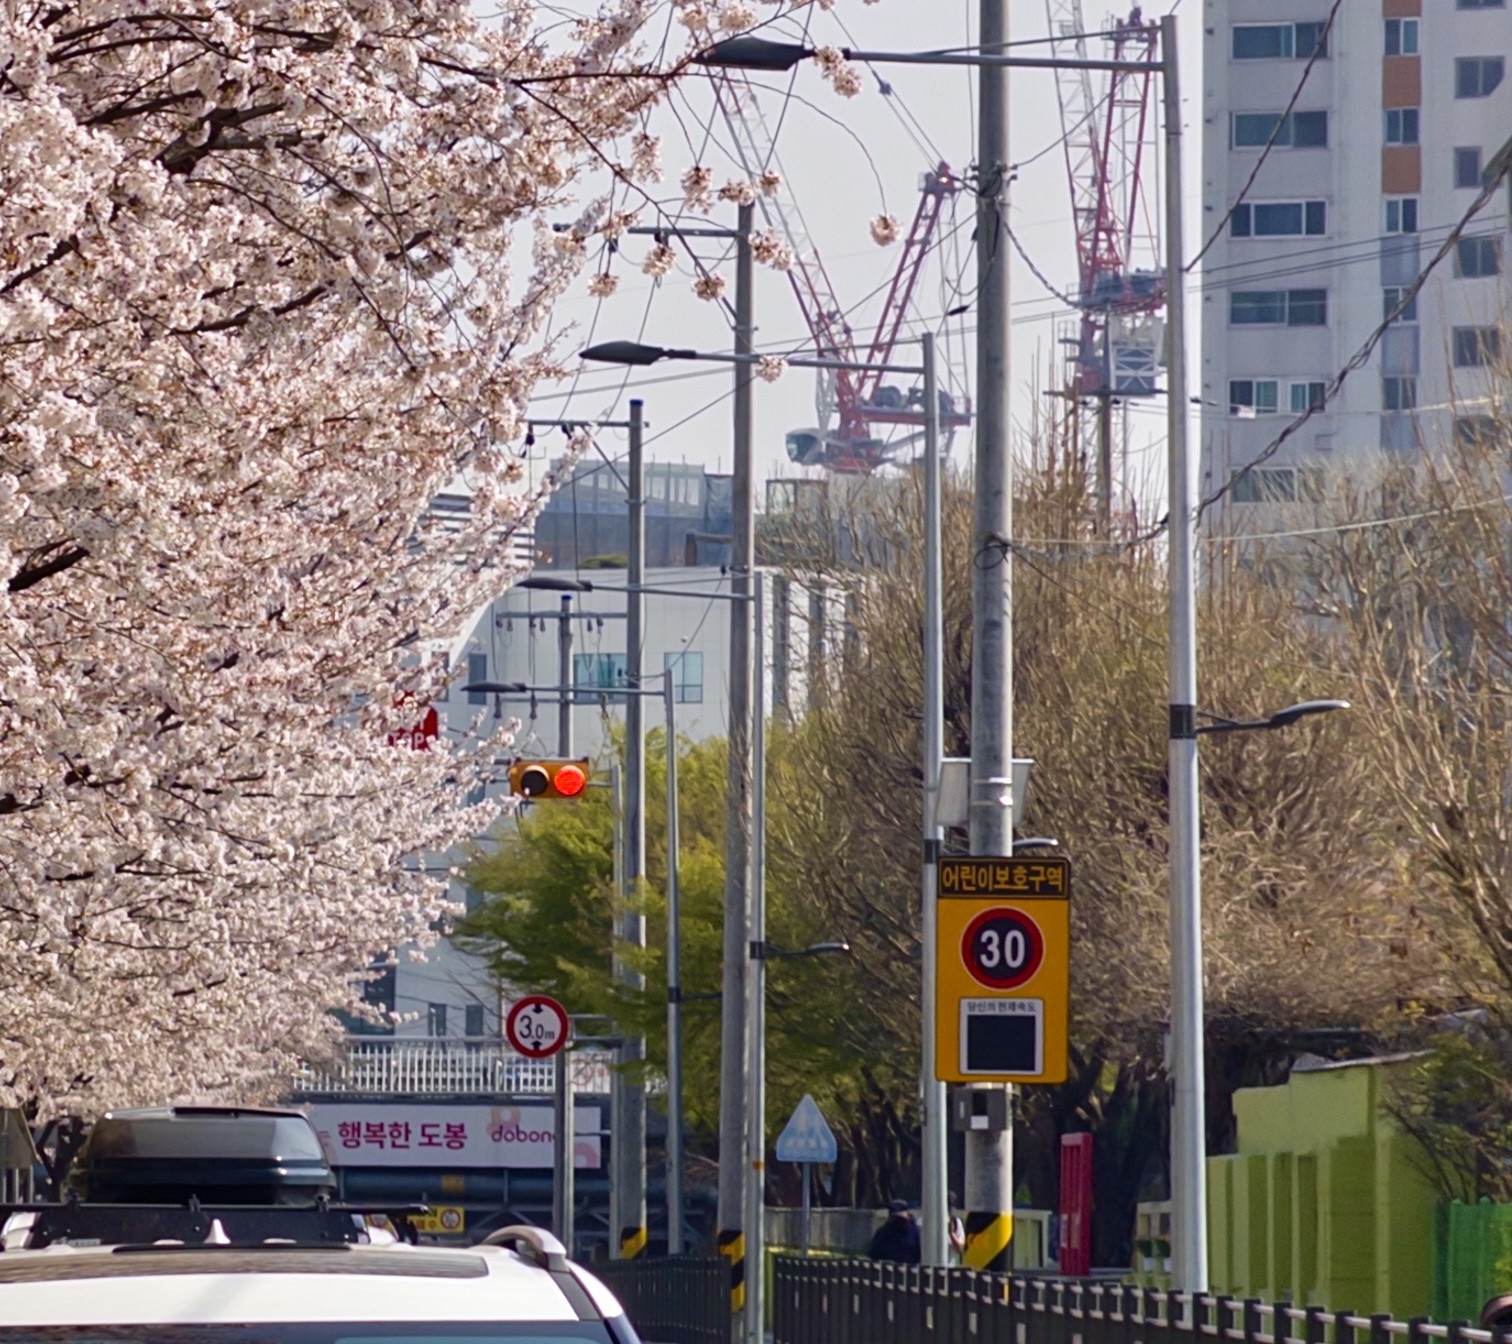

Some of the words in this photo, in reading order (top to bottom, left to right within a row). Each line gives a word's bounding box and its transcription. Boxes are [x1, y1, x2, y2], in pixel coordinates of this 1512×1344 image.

[942, 864, 1064, 893] 어린이보호구역
[979, 929, 1026, 968] 30
[338, 1121, 412, 1149] 행복한
[418, 1122, 467, 1150] 도봉
